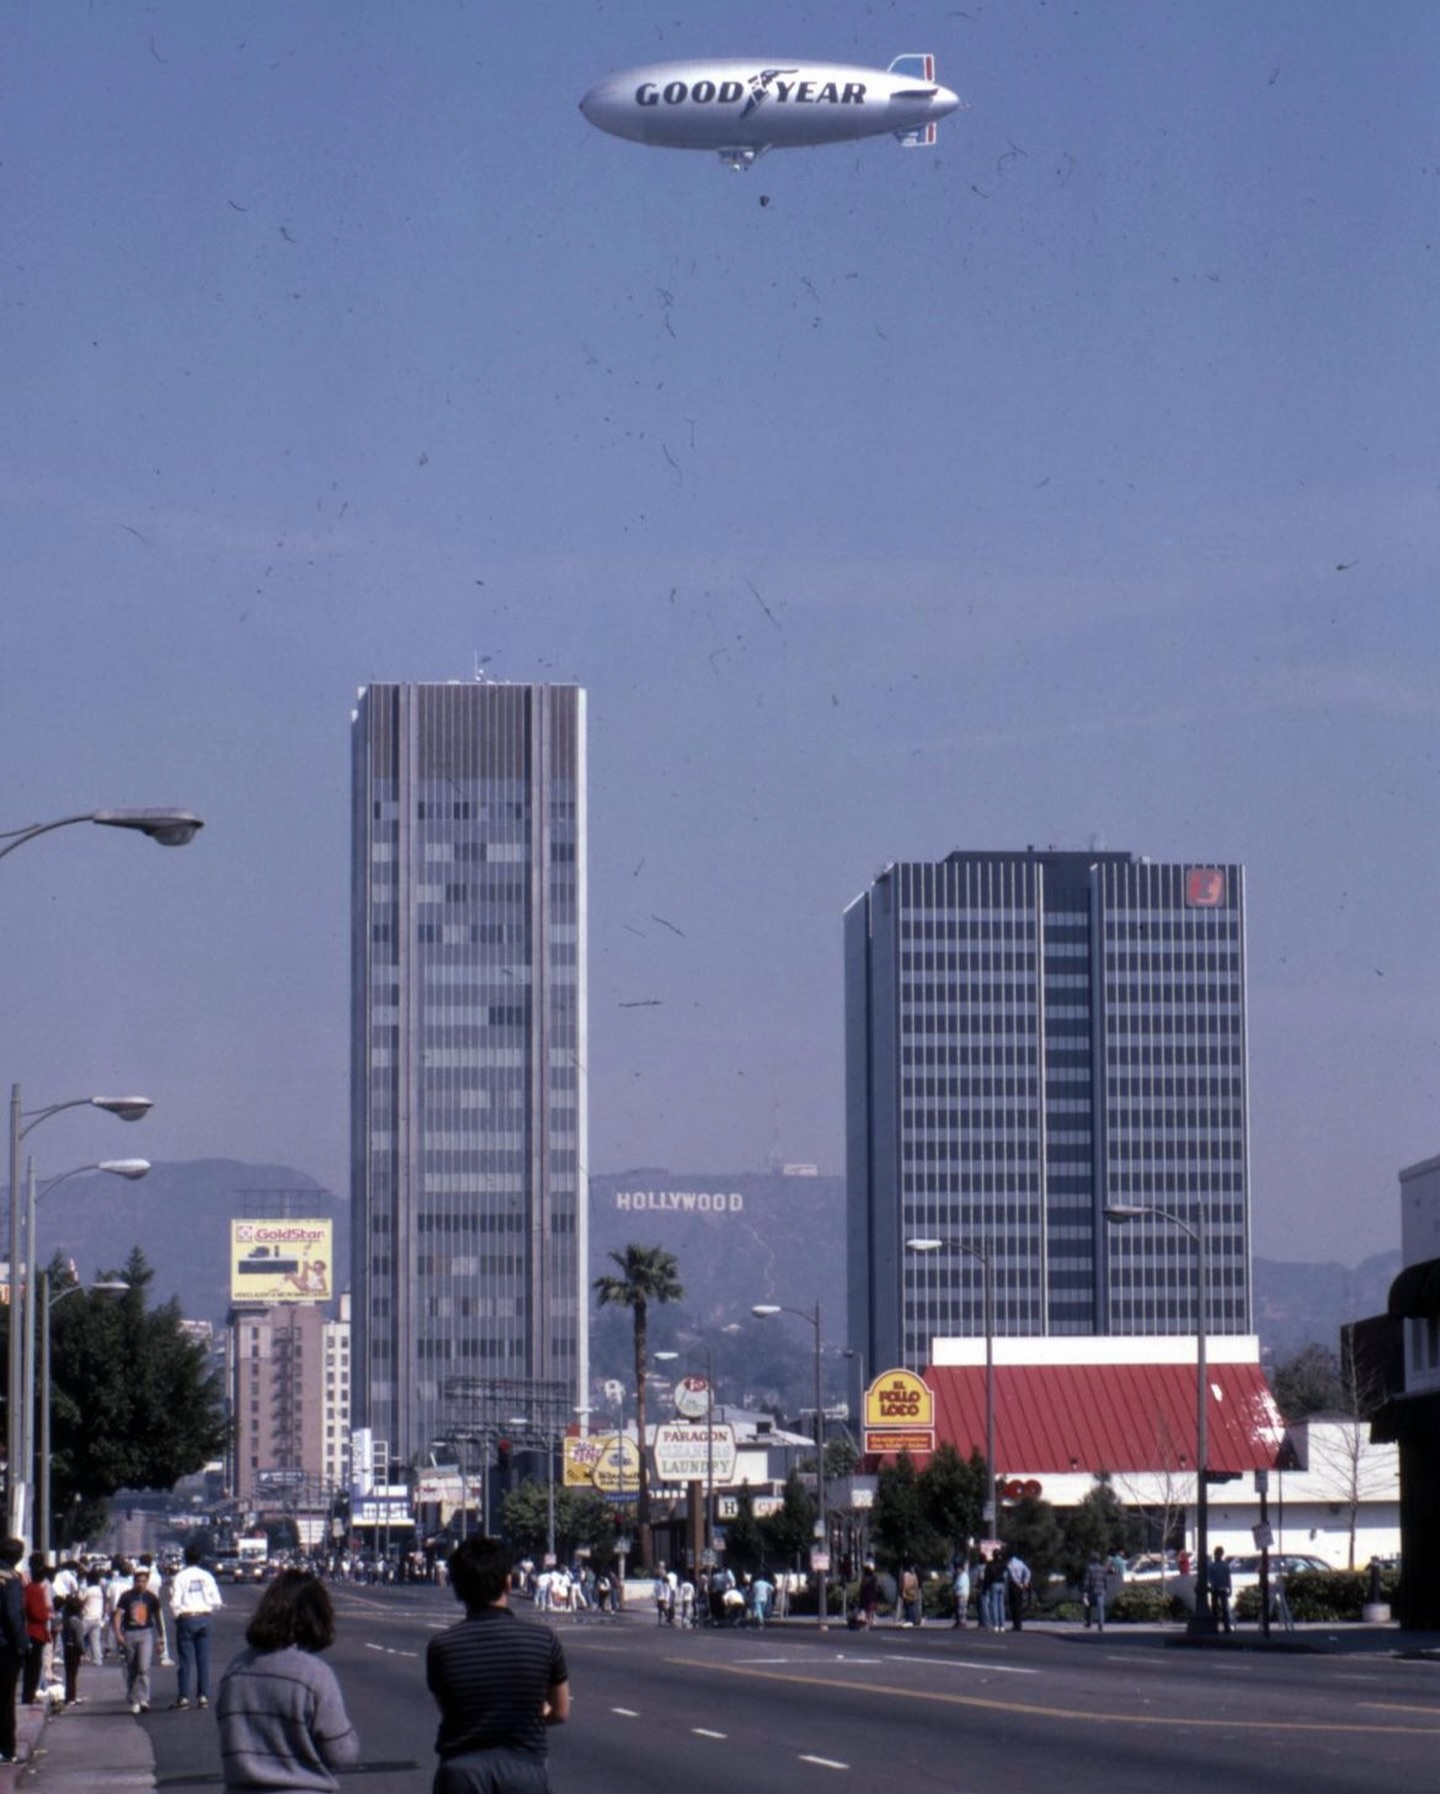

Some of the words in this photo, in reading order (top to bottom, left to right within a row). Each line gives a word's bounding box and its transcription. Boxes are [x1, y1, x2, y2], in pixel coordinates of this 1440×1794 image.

[635, 81, 744, 106] GOOD
[776, 81, 867, 105] YEAR
[616, 1191, 744, 1211] HOLLYWOOD
[256, 1228, 323, 1242] GoldStar
[893, 1380, 906, 1390] EL
[879, 1390, 921, 1403] POLLO
[880, 1403, 920, 1417] LOCO
[663, 1431, 728, 1442] PARAGON
